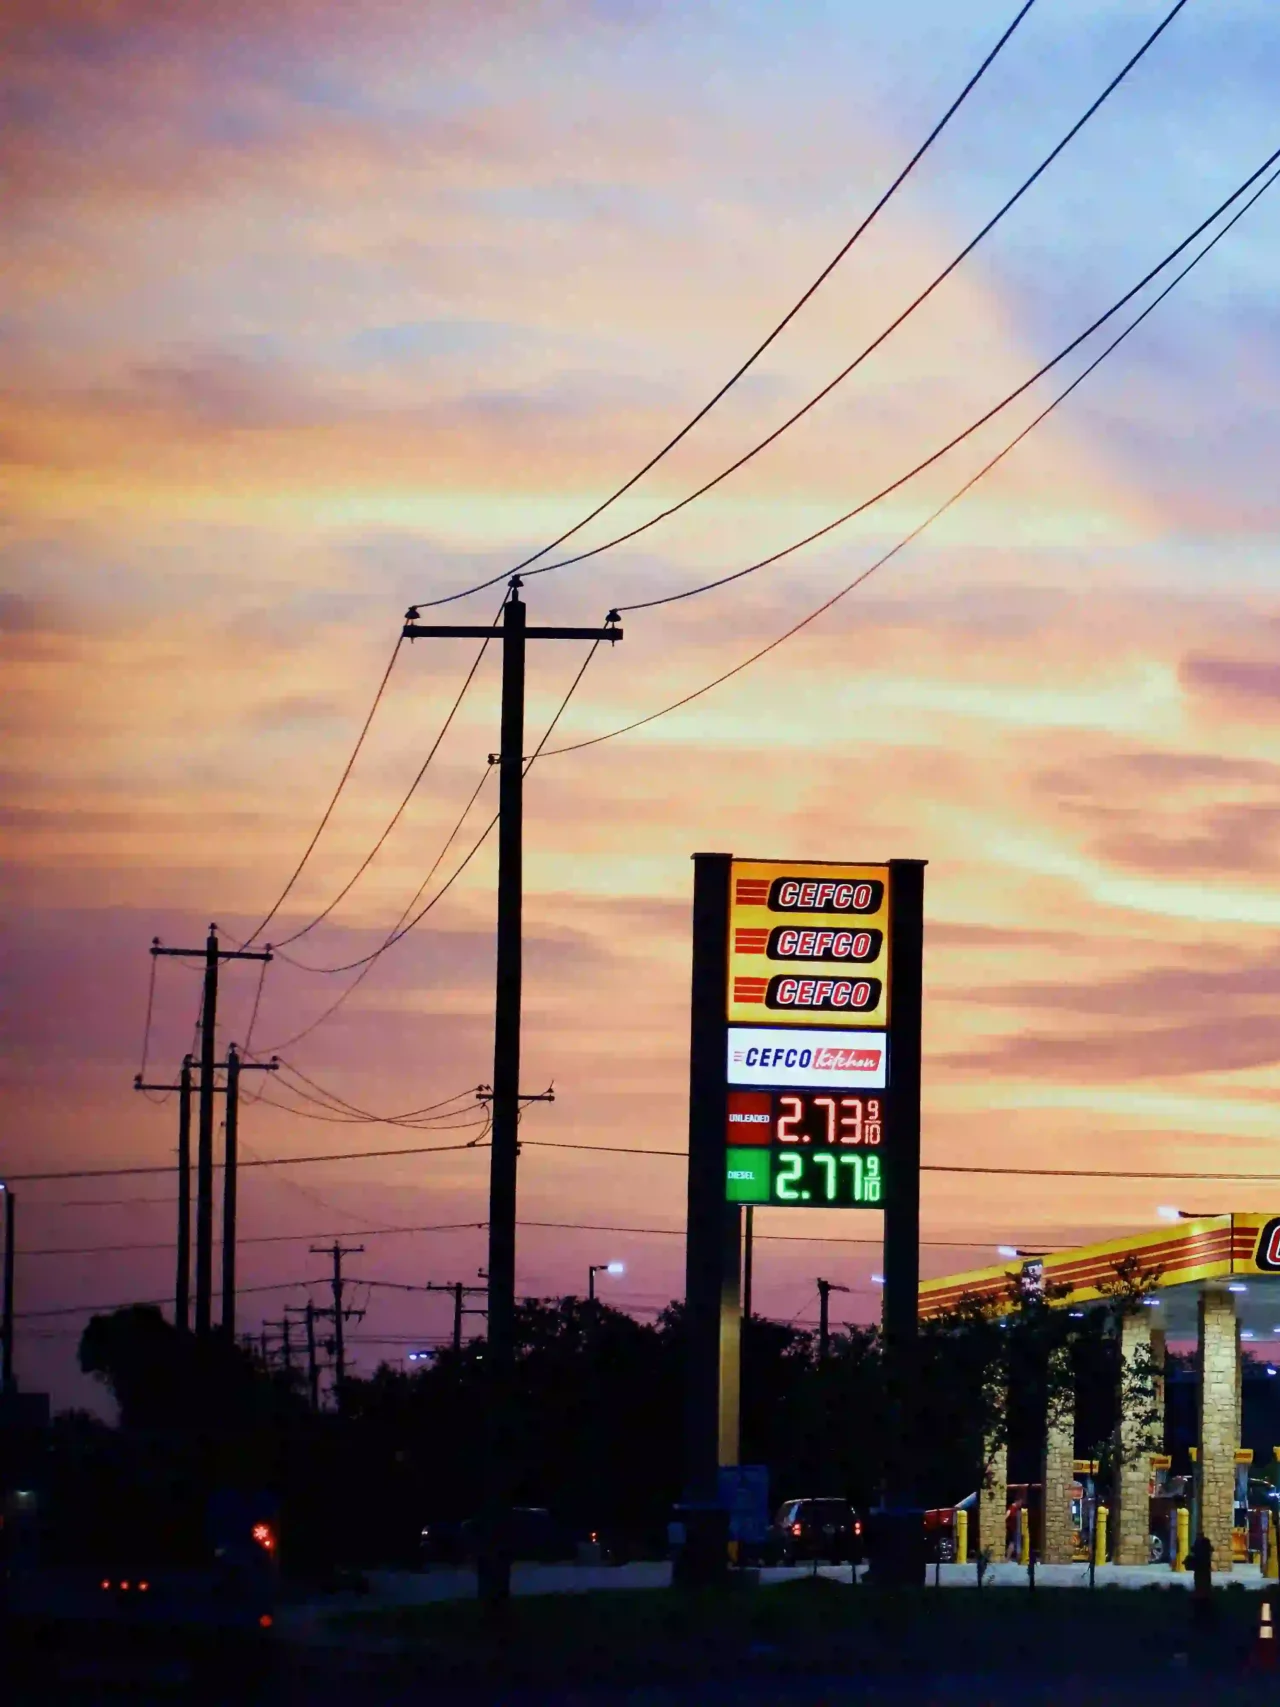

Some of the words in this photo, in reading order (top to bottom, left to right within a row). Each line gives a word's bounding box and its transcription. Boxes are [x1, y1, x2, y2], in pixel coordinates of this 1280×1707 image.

[778, 881, 872, 909] CEFCO
[777, 930, 871, 958] CEFCO
[776, 979, 870, 1006] CEFCO
[745, 1047, 812, 1068] CEFCO
[814, 1049, 876, 1070] Kitchen
[729, 1114, 770, 1123] UNLEADED
[777, 1097, 862, 1144] 2.73
[776, 1152, 862, 1201] 2.77
